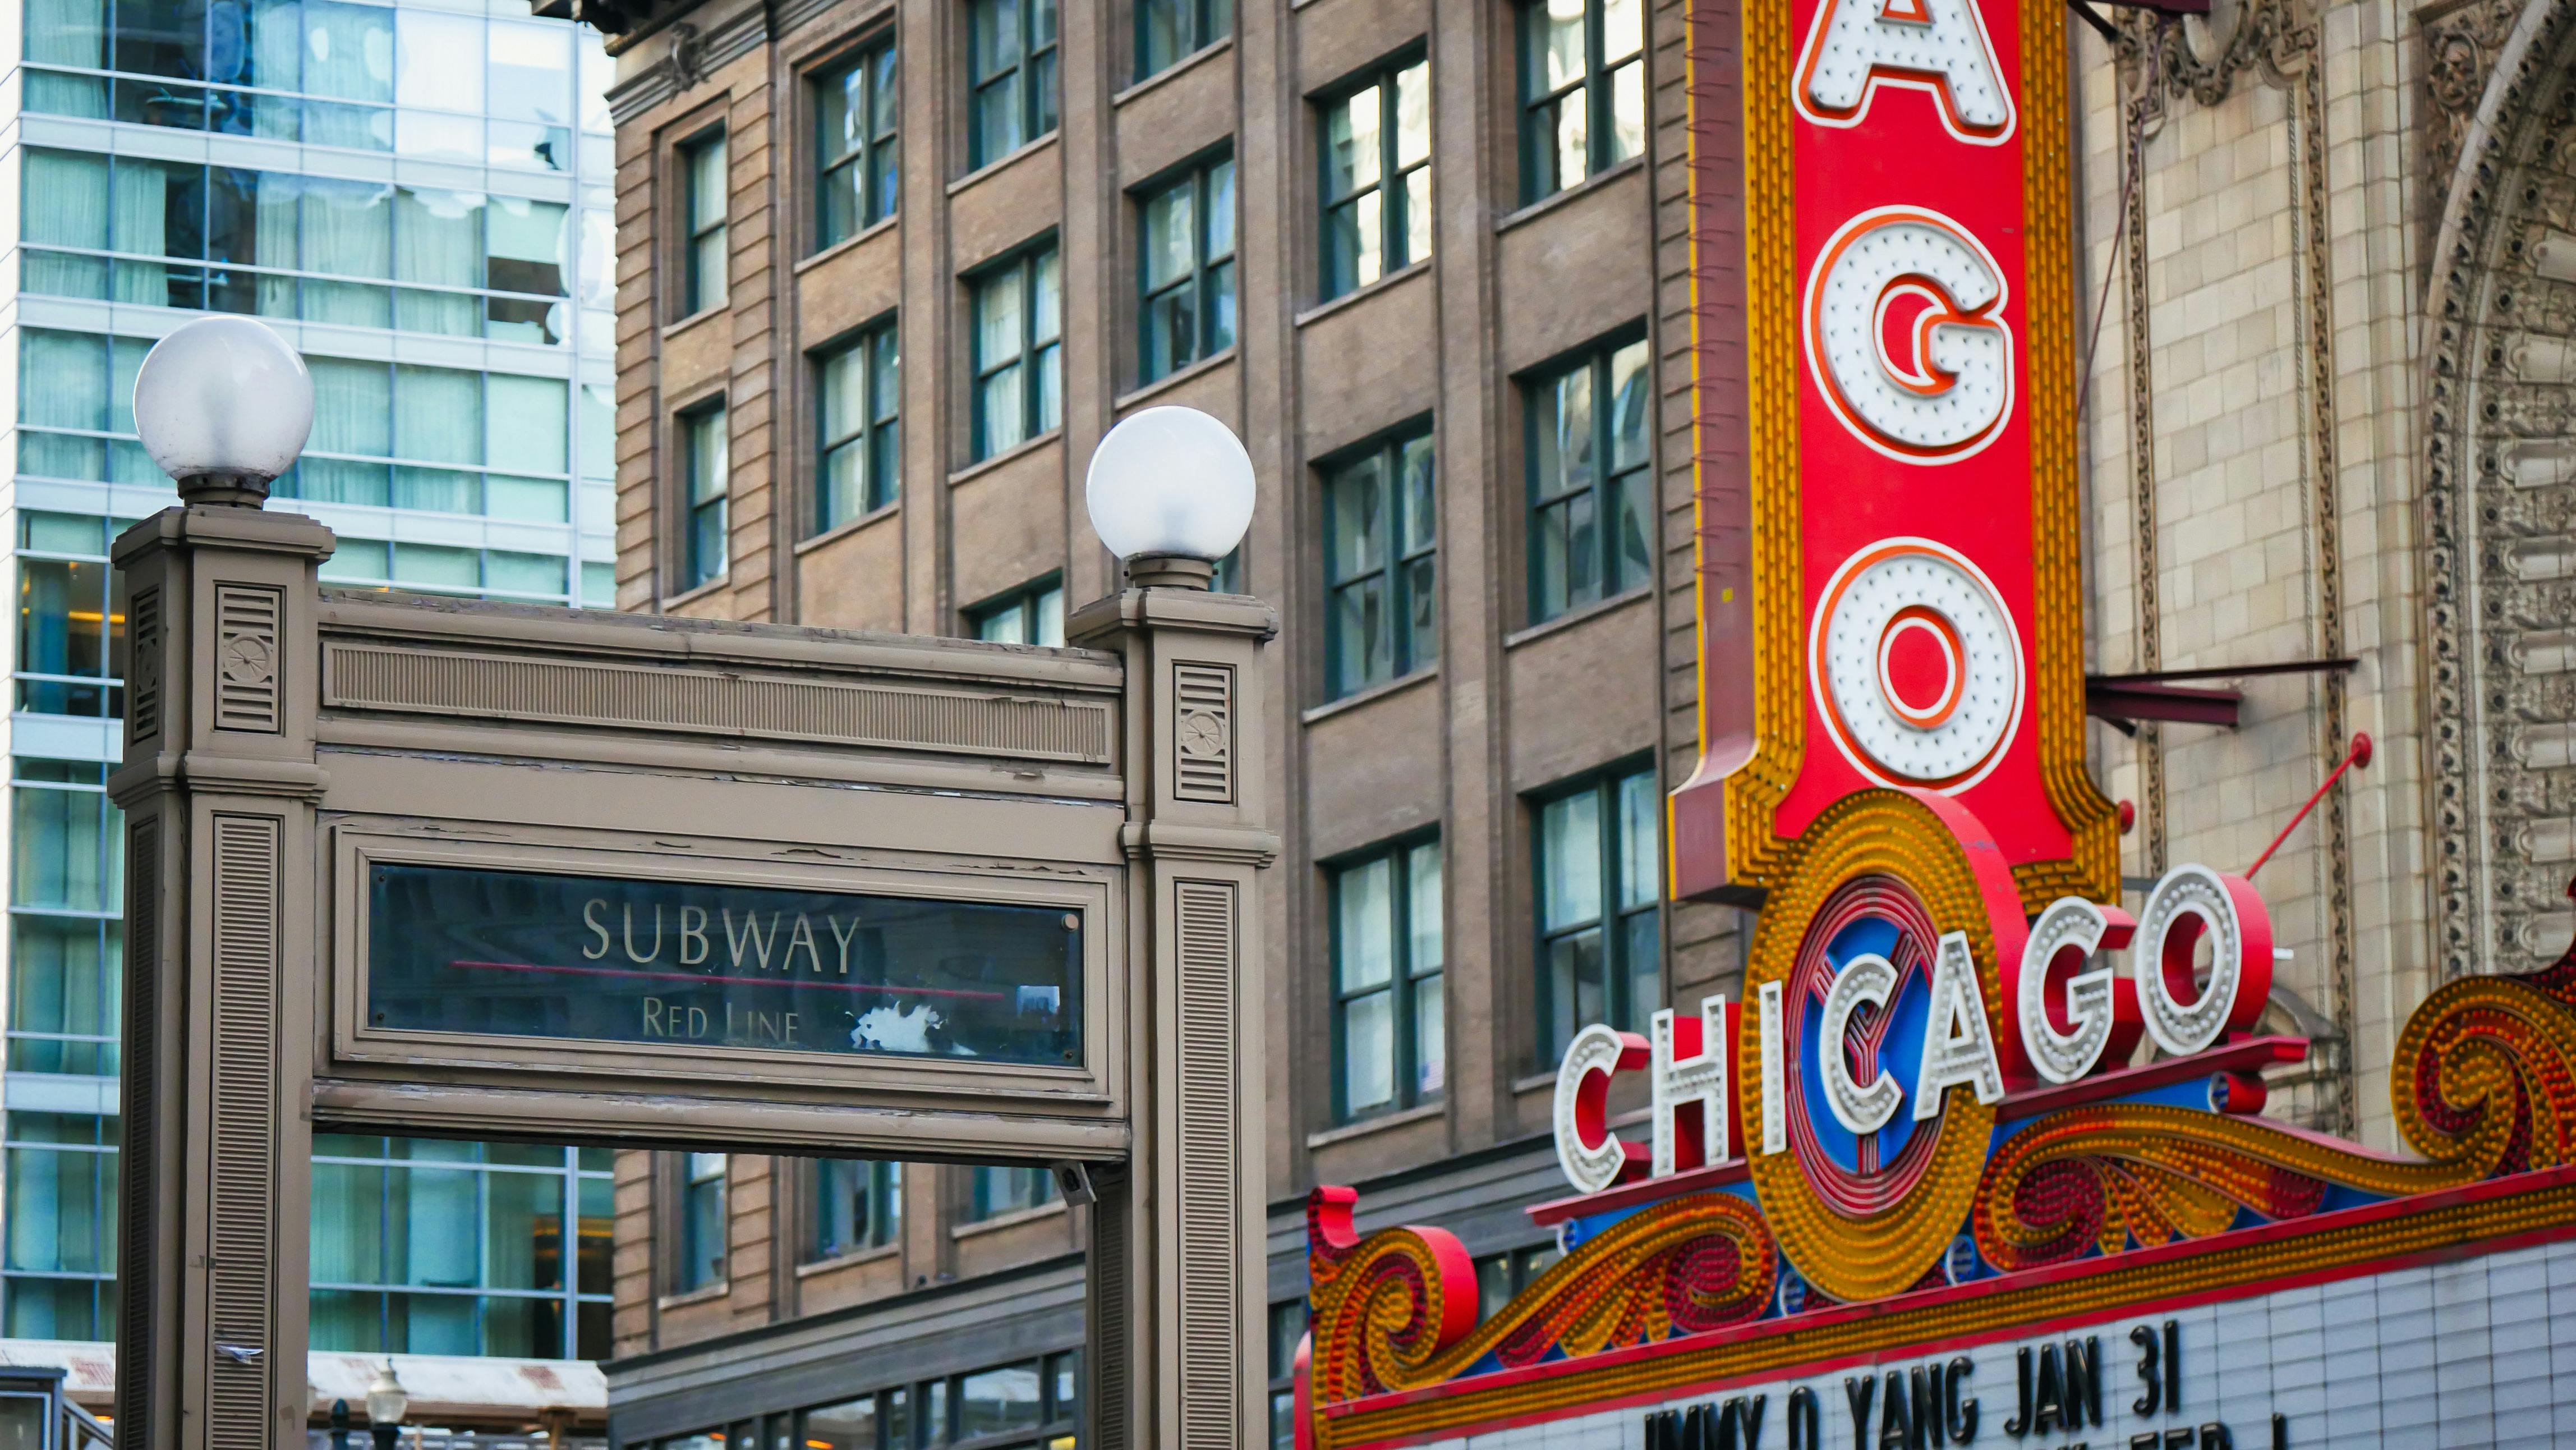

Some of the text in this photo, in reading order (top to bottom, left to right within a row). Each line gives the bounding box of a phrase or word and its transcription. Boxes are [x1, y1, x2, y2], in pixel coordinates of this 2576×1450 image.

[582, 898, 861, 974] SUBWAY
[1553, 862, 2243, 1193] CHICAGO
[1844, 1356, 1979, 1450] YANG
[2004, 1336, 2102, 1438] JAN
[2129, 1319, 2181, 1418] 31
